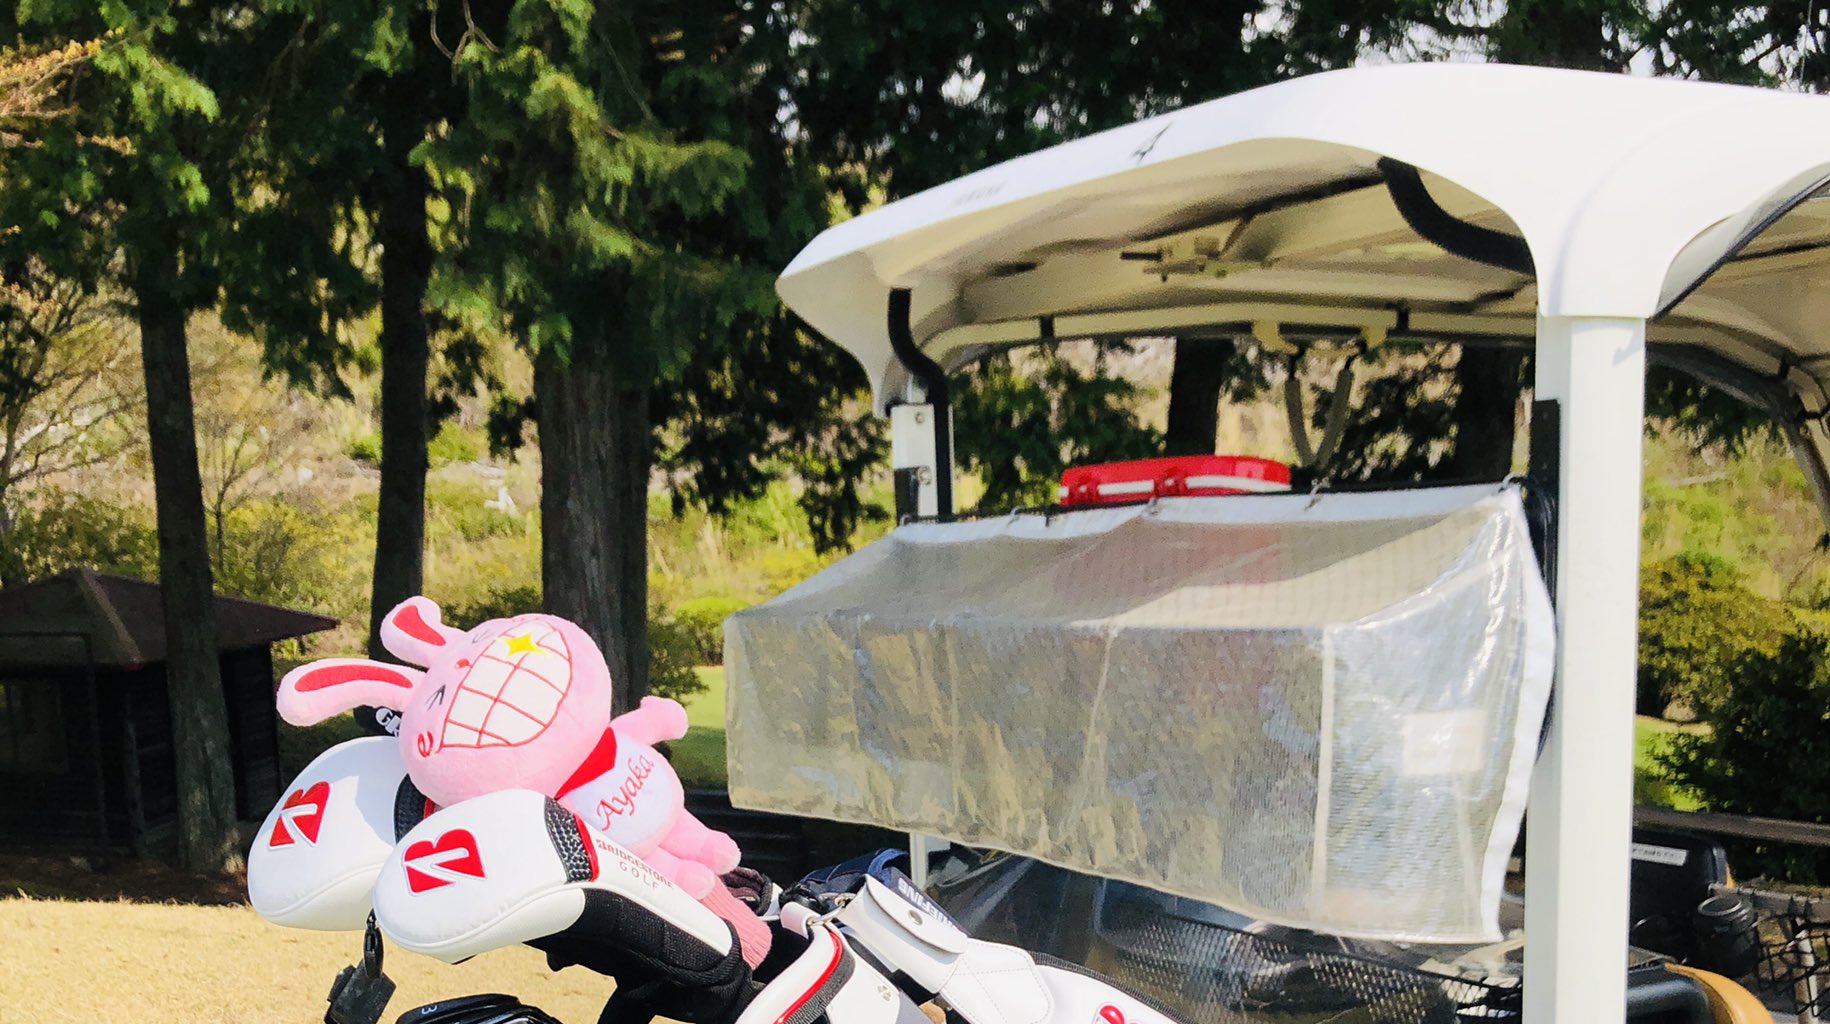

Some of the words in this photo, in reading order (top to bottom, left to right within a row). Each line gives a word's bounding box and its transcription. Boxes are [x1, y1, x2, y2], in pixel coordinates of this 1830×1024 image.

[596, 754, 654, 832] Ayaka
[596, 839, 673, 888] BRIDGESTONE
[619, 861, 660, 890] GOLF
[897, 877, 958, 929] IEFING
